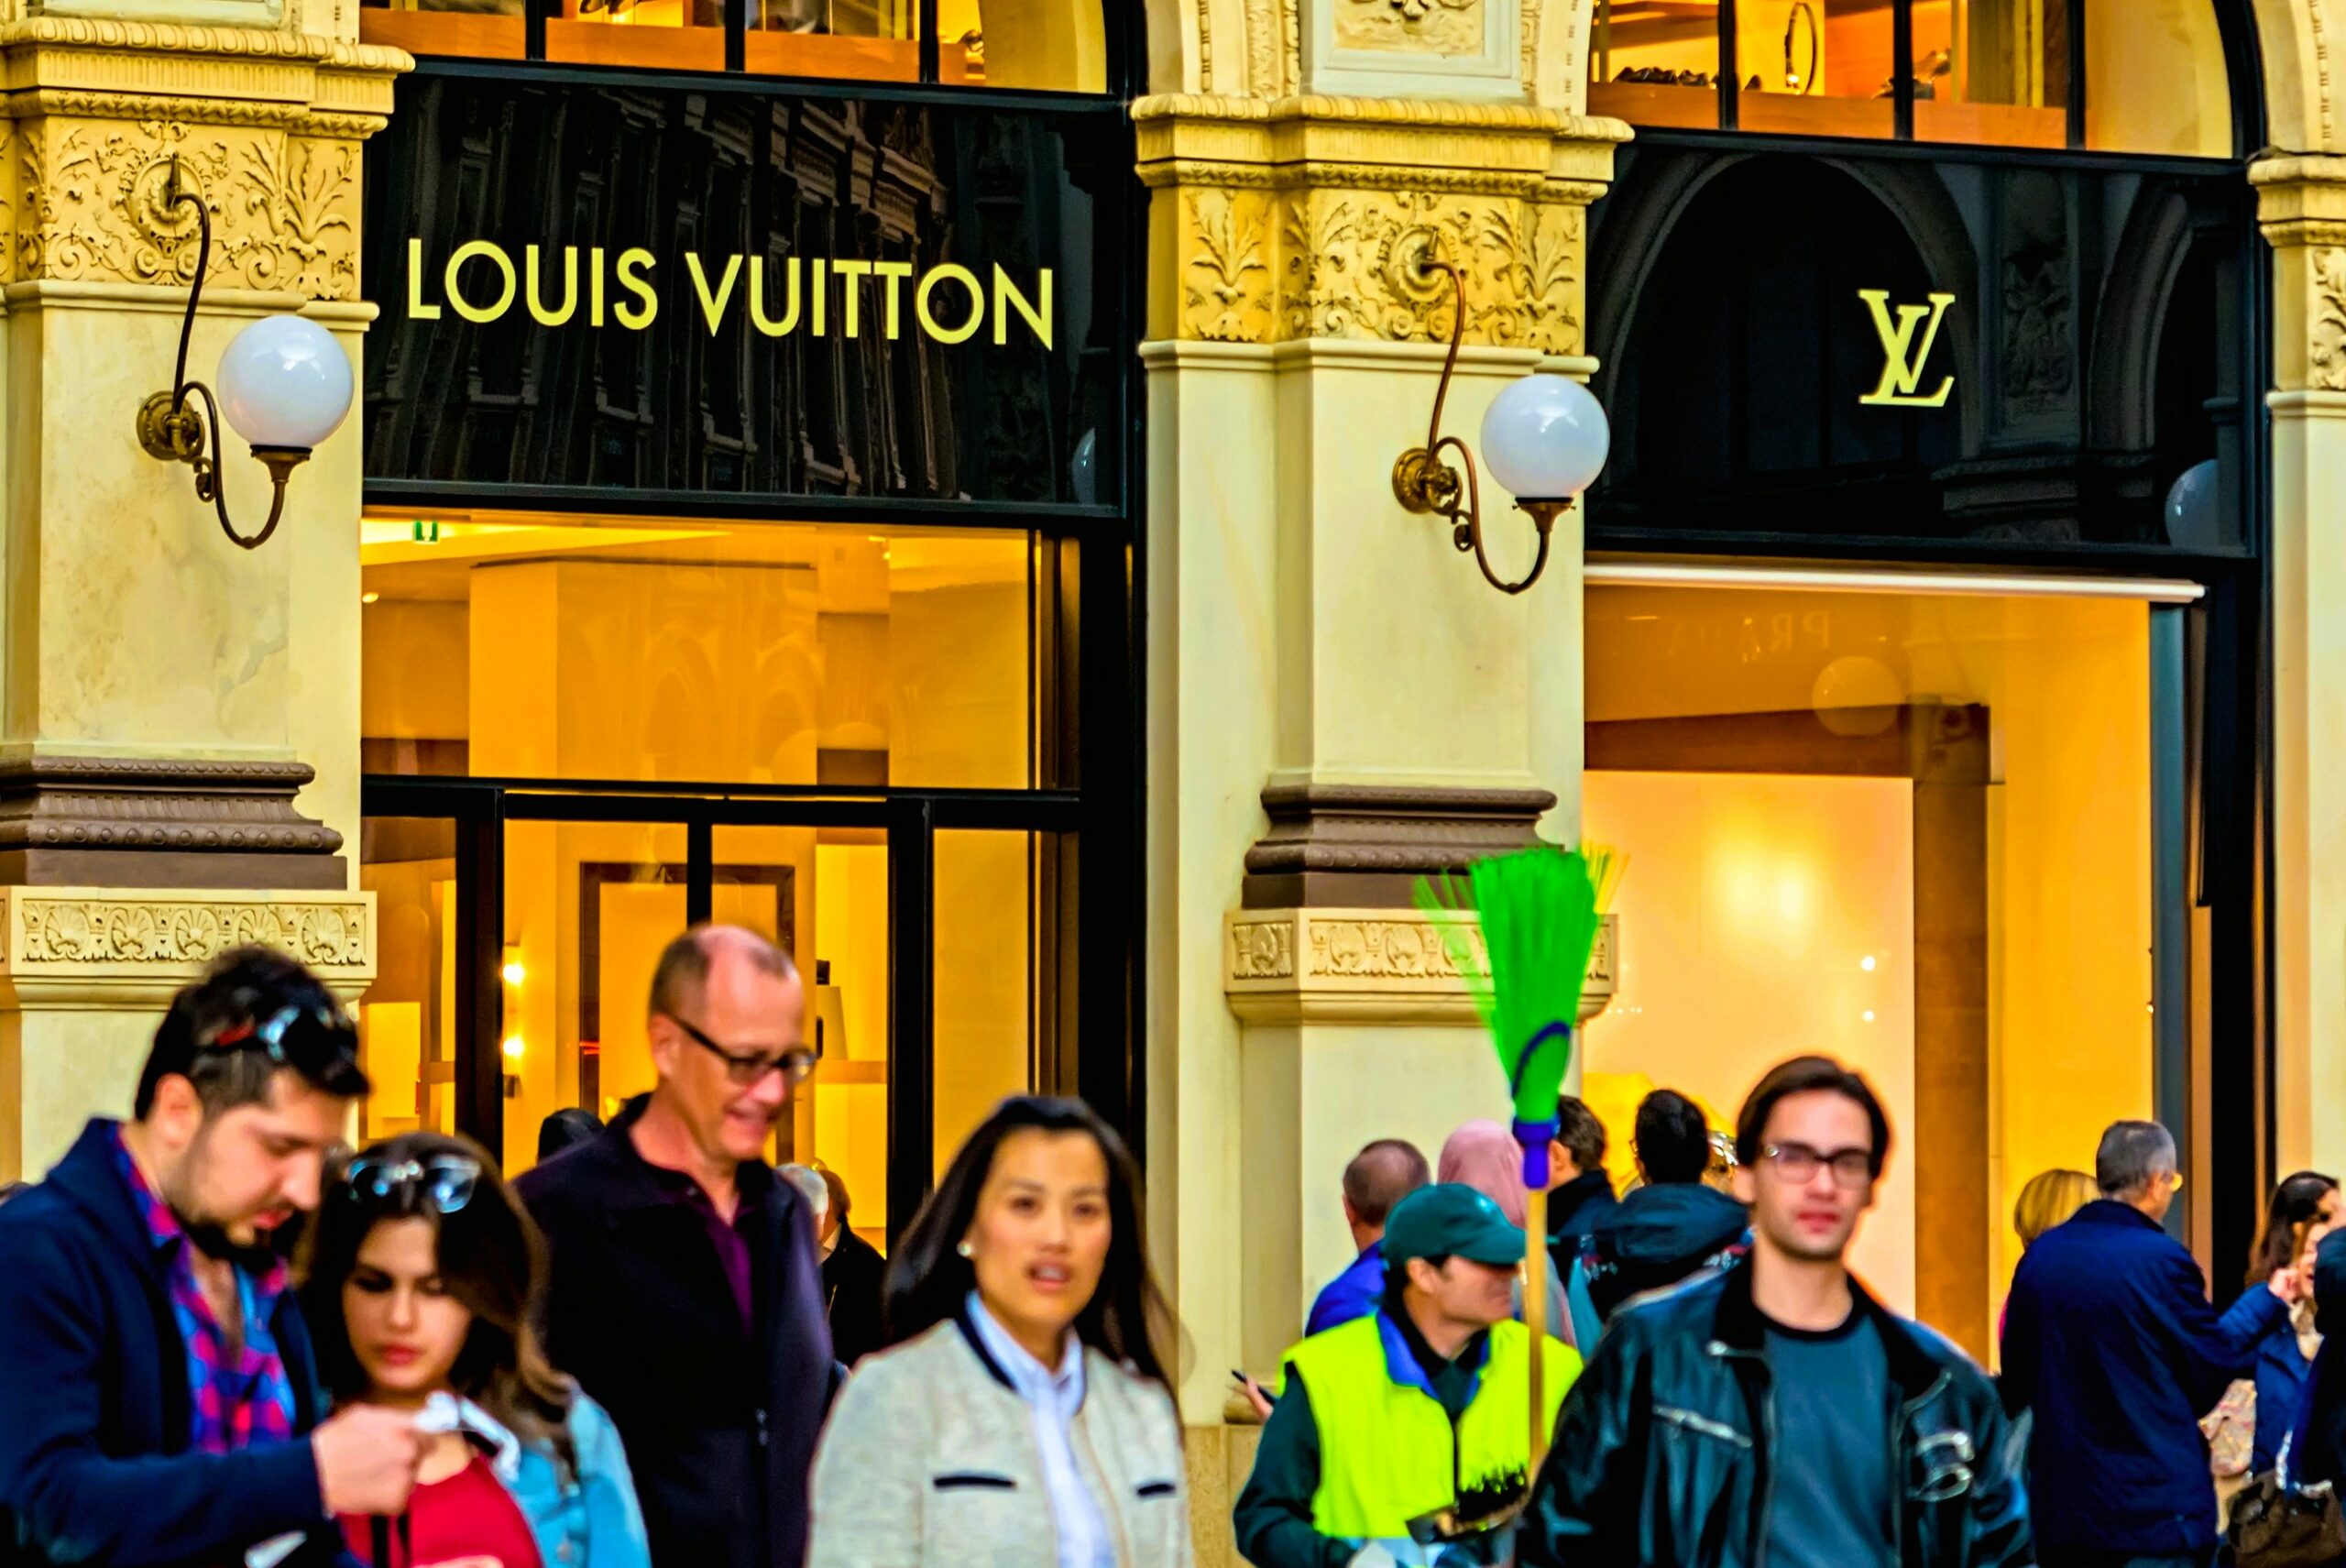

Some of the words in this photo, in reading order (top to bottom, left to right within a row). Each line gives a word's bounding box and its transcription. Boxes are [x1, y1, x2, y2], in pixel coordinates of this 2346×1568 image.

[408, 237, 658, 330] LOUIS
[685, 252, 1053, 351] VUITTON
[1858, 289, 1956, 408] LV
